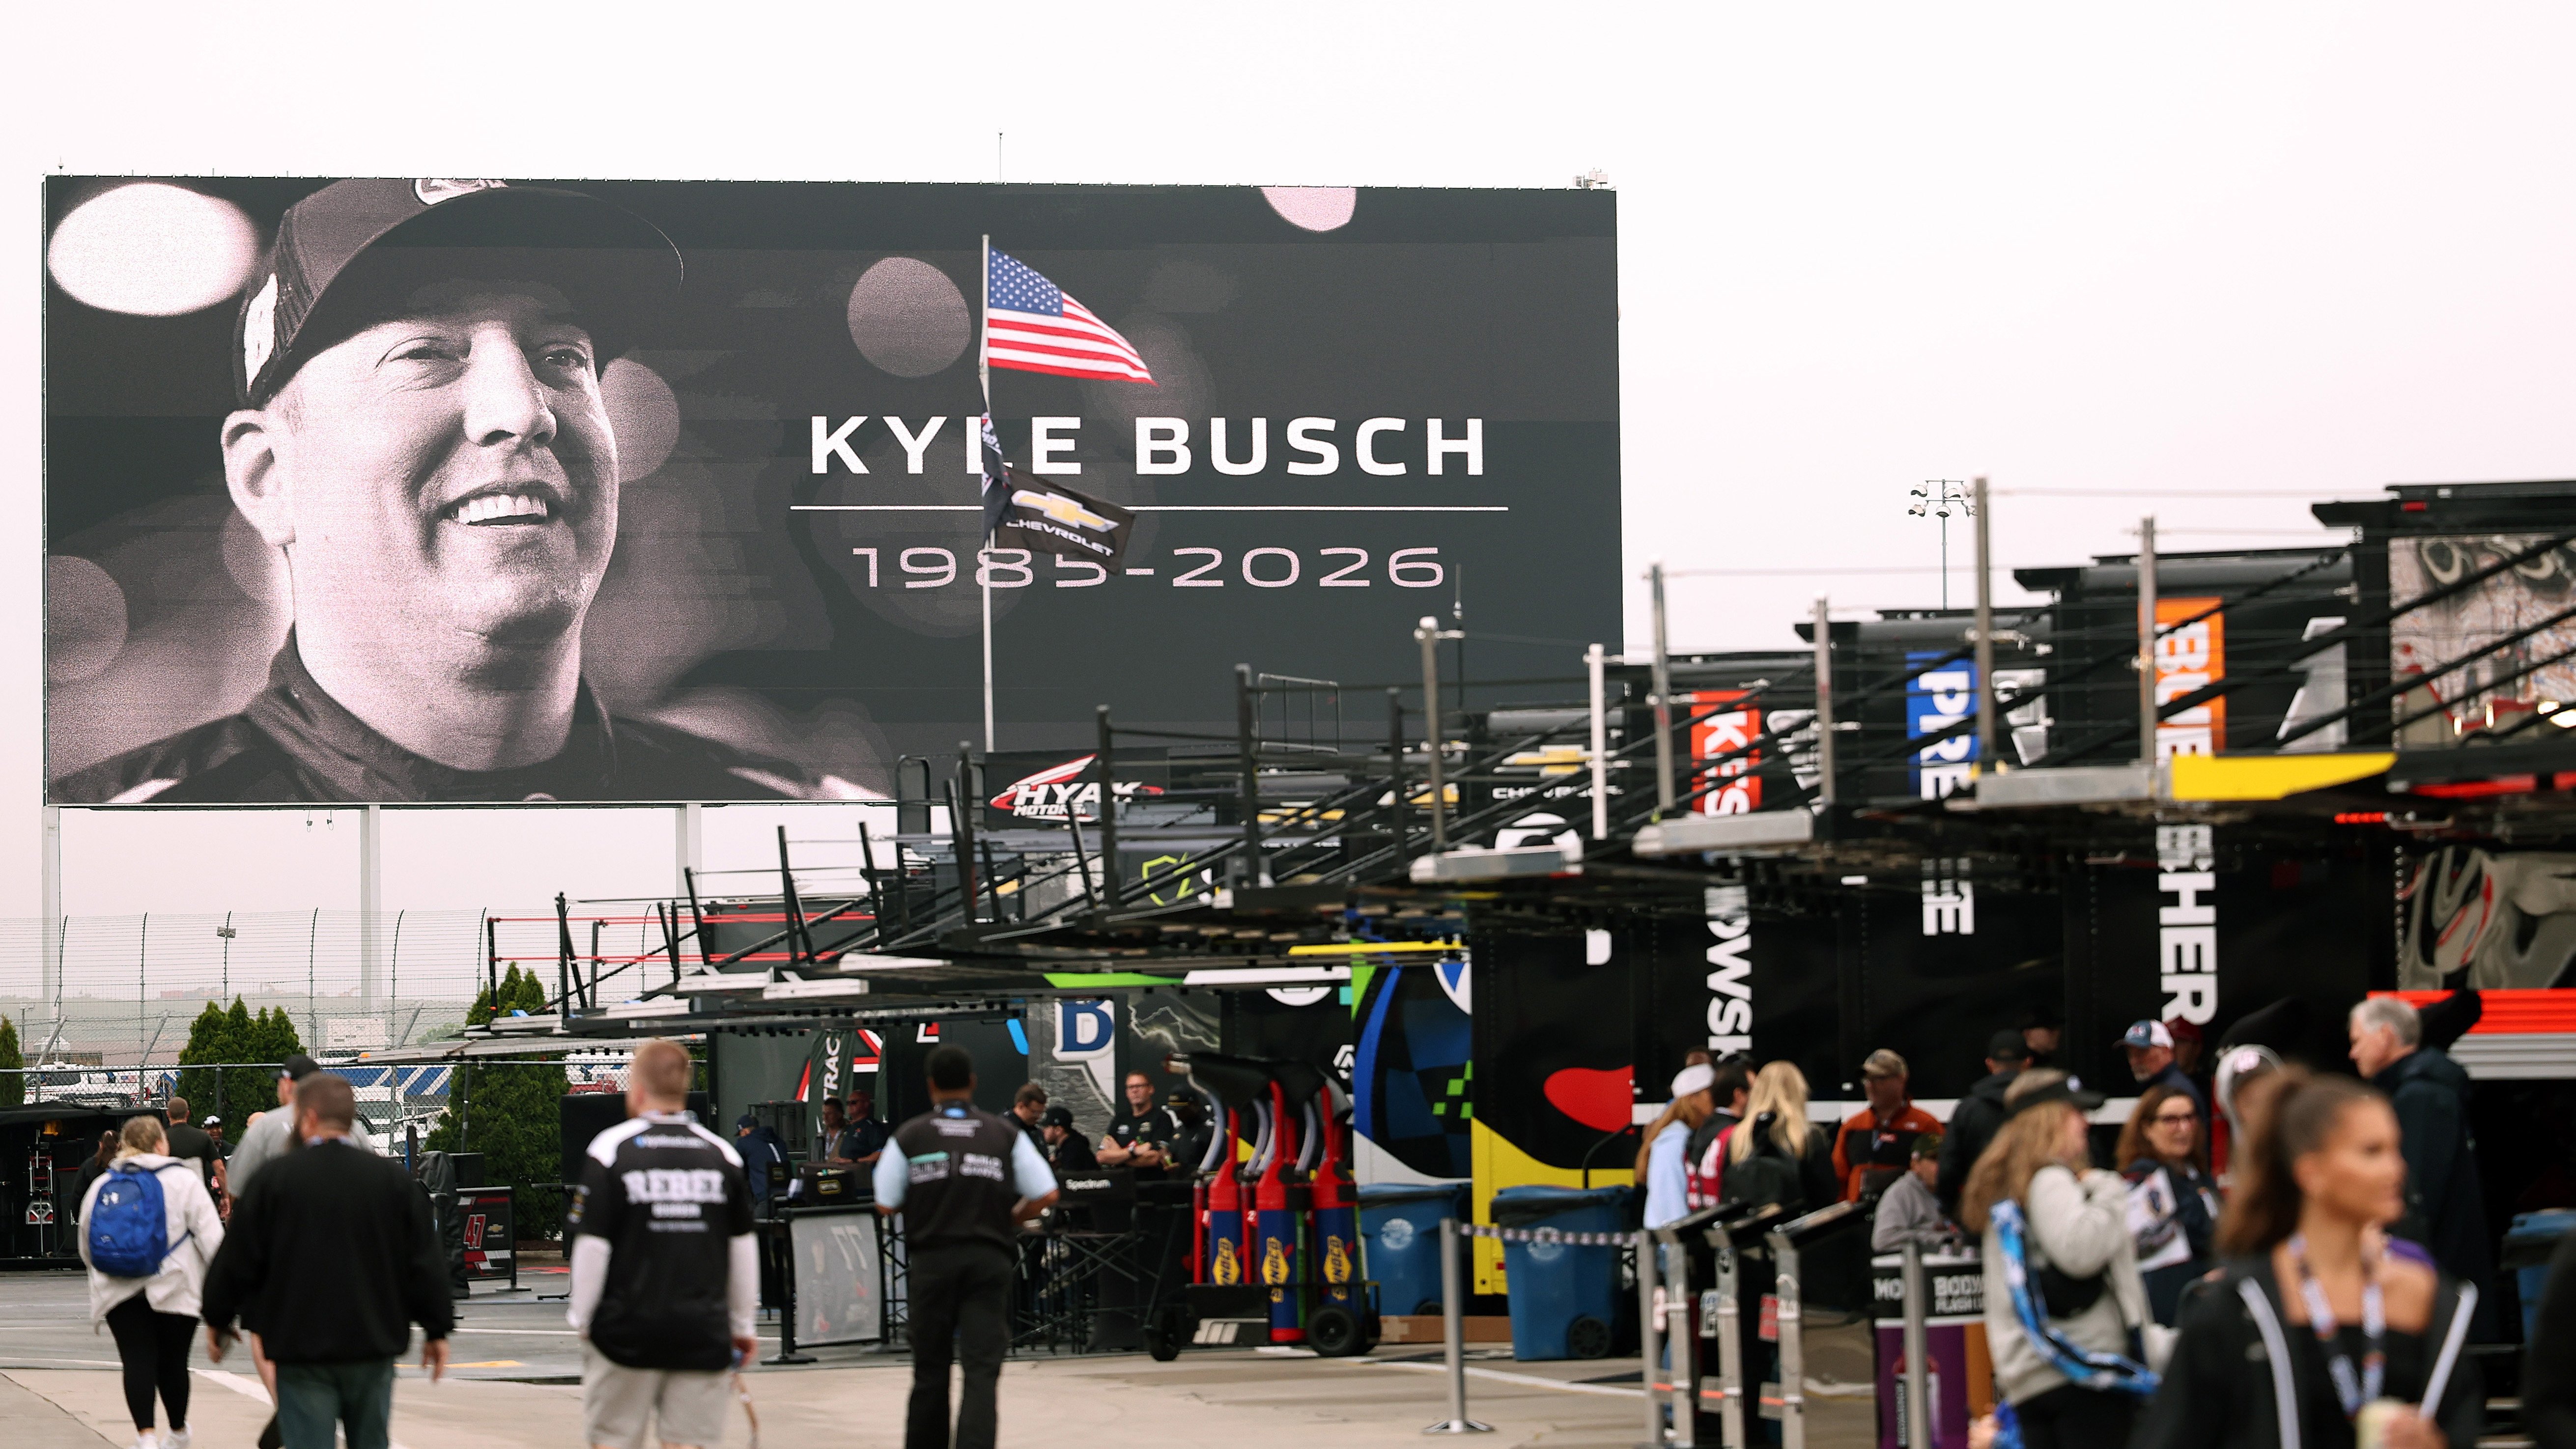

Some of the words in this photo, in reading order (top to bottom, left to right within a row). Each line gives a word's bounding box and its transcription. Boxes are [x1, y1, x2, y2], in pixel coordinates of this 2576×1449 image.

[811, 416, 1081, 475] KYLE
[1135, 417, 1483, 476] BUSCH
[852, 547, 1444, 588] 1985-2026
[1013, 782, 1142, 804] HYAK
[622, 1168, 728, 1204] REBEL
[1065, 1179, 1111, 1191] Spectrum
[463, 1214, 486, 1249] 47
